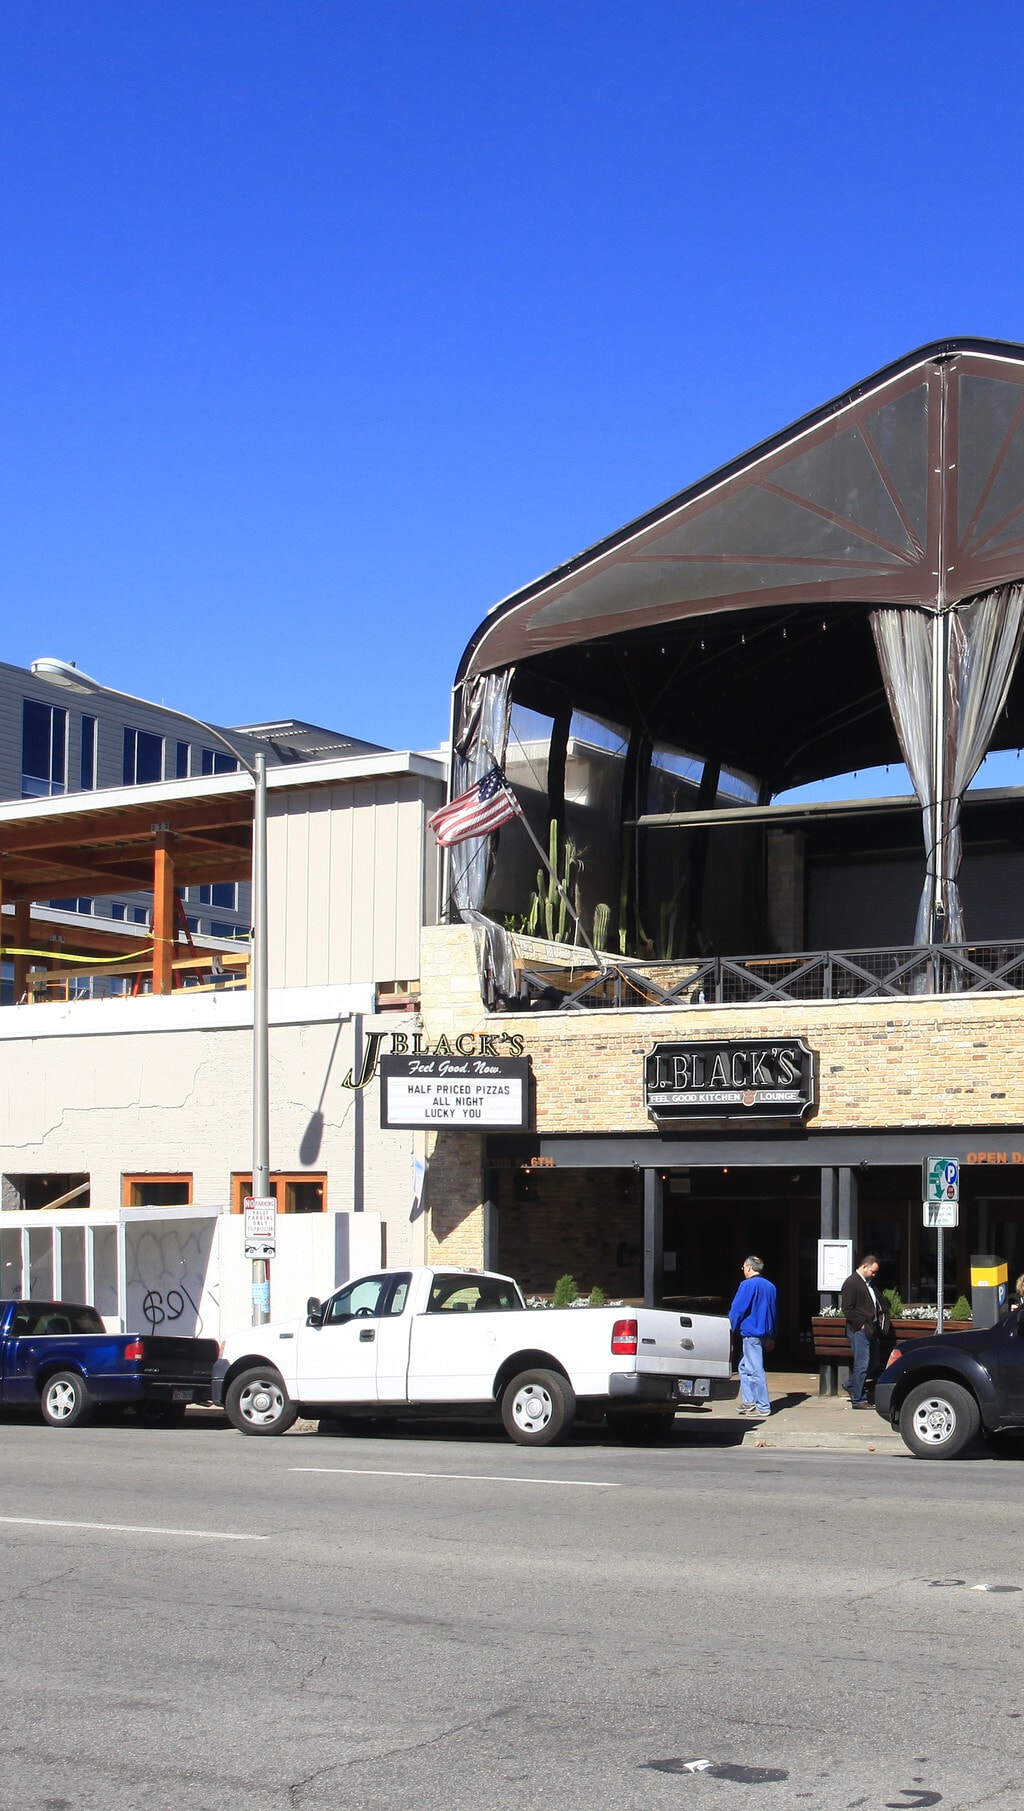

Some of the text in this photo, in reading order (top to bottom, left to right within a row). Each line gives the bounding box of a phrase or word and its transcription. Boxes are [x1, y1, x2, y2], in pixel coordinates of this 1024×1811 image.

[390, 1032, 525, 1056] BLACK'S
[408, 1060, 502, 1077] Feel Good. Now.
[407, 1084, 510, 1095] HALF PRICED PIZZAS
[432, 1097, 485, 1106] ALL NIGHT
[650, 1092, 797, 1103] FEEL GOOD KITCHEN LOUNGE
[425, 1108, 482, 1118] LUCKY YOU
[530, 1156, 555, 1167] 6TH
[966, 1152, 1007, 1163] OPEN
